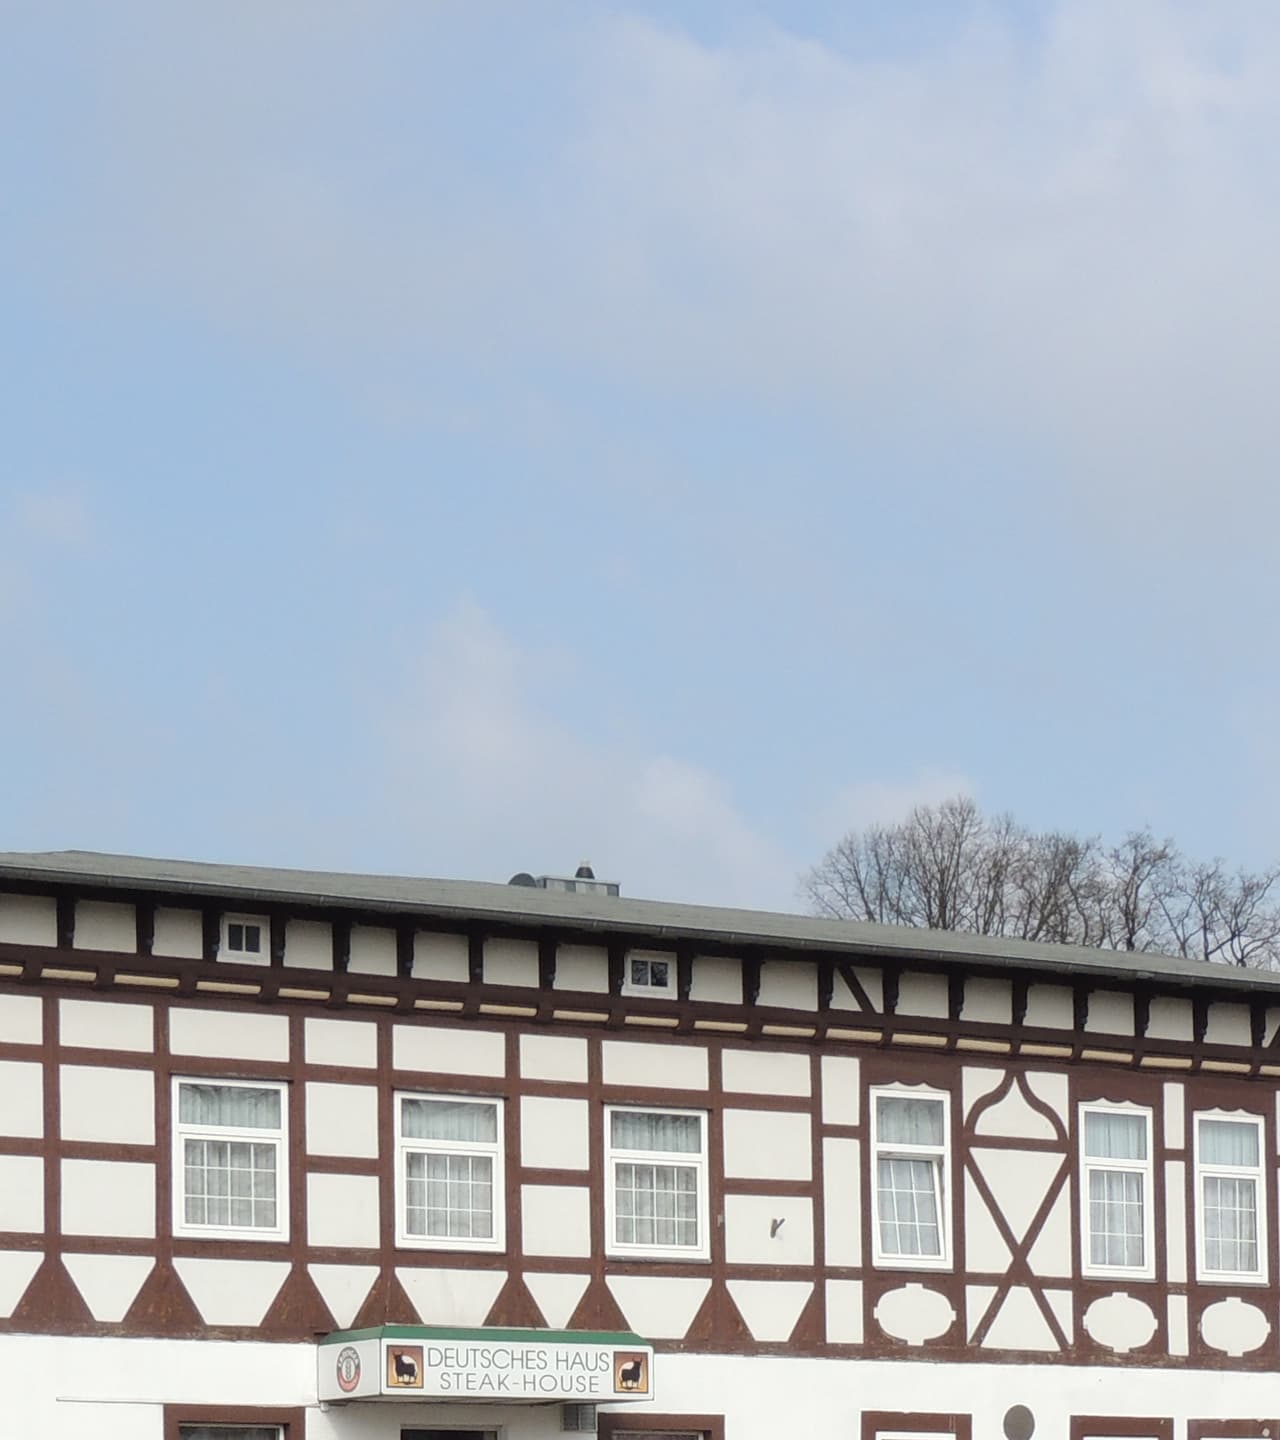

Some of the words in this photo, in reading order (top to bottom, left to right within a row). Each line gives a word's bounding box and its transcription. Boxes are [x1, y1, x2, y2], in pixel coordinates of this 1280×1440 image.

[427, 1347, 548, 1370] DEUTSCHES
[555, 1351, 610, 1372] HAUS
[439, 1372, 600, 1393] STEAK-HOUSE
